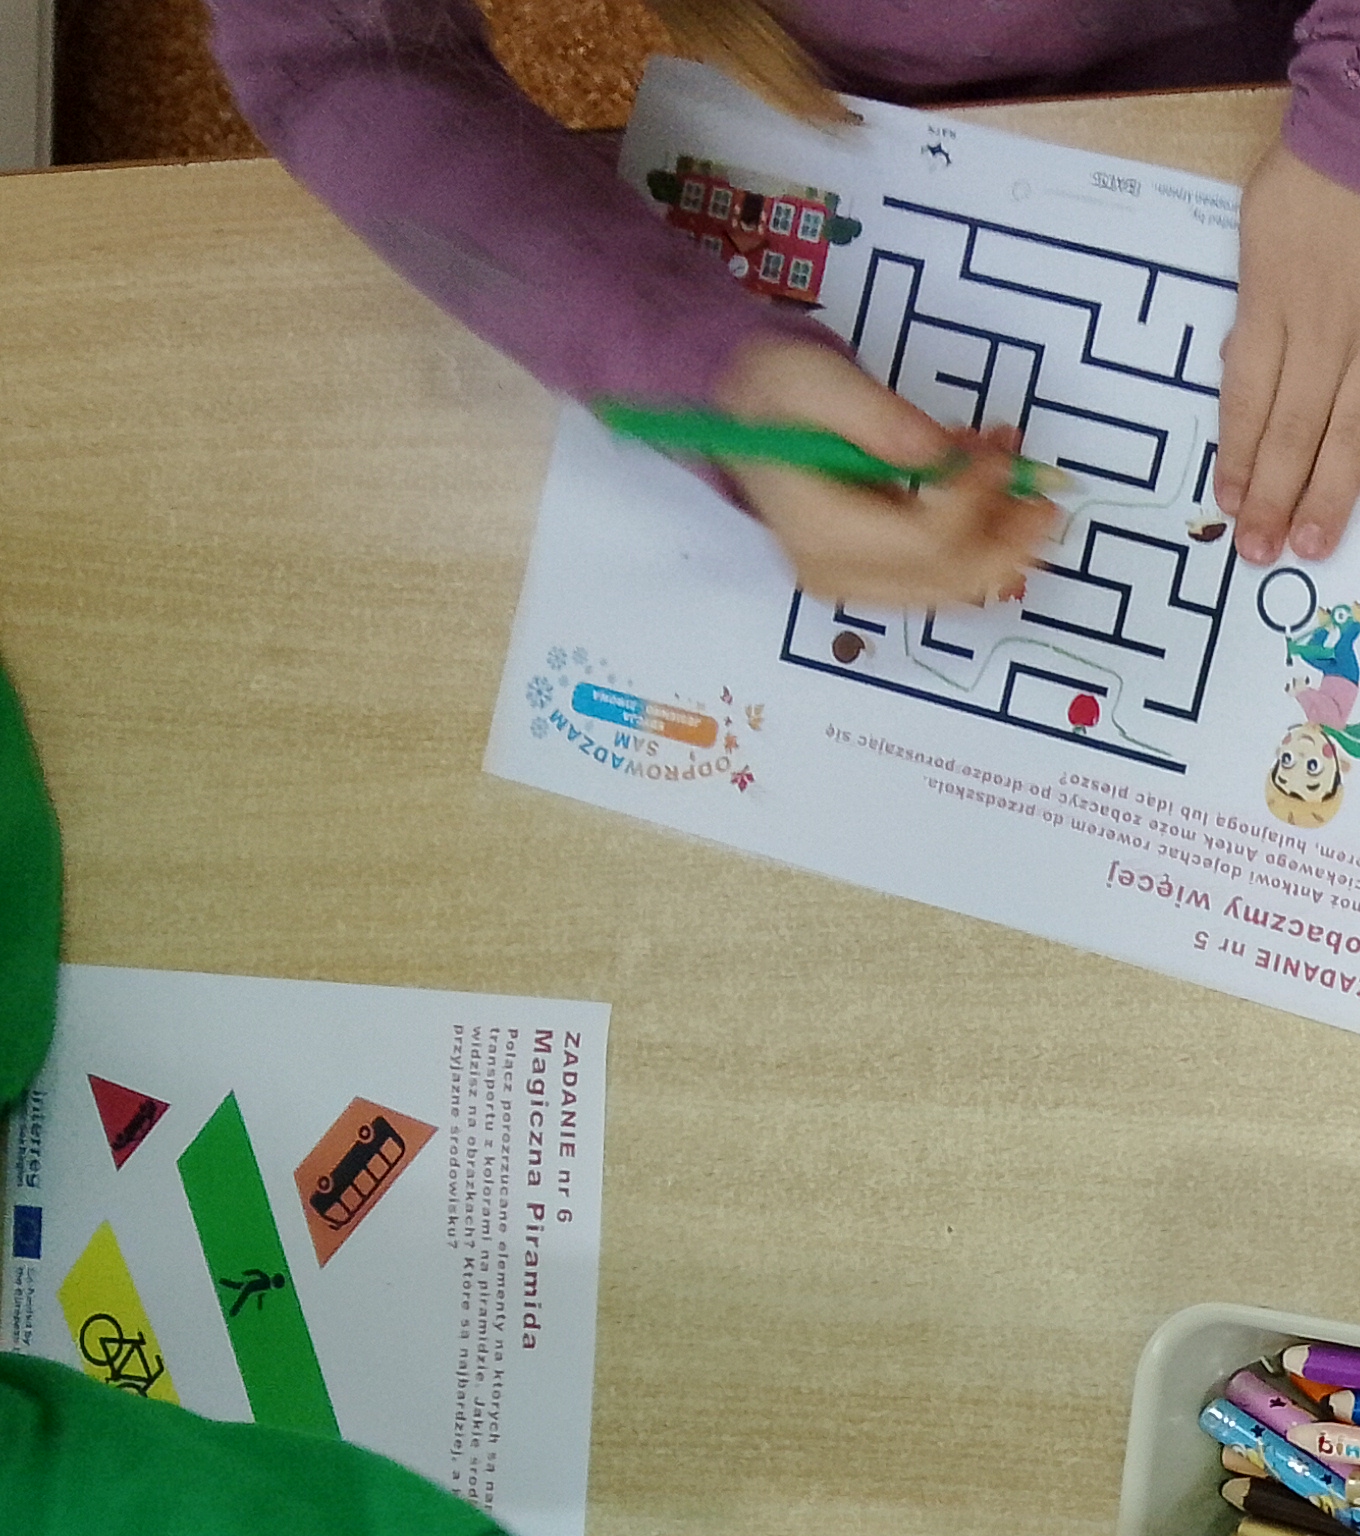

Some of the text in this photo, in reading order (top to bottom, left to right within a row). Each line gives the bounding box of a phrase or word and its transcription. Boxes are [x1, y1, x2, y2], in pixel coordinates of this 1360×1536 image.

[549, 708, 731, 778] ODPROWADZAM
[611, 730, 660, 757] SAM
[1105, 859, 1211, 912] więcej
[1193, 930, 1210, 951] 5
[1217, 937, 1247, 958] nr
[555, 1030, 582, 1224] ZADANIE nr 6
[497, 1099, 513, 1234] porozrzucane
[521, 1028, 555, 1350] Magiczna Piramida
[469, 1026, 502, 1449] transportu kolorami na Jakie
[491, 1240, 510, 1333] elementy
[493, 1338, 505, 1363] na
[484, 1451, 498, 1474] są
